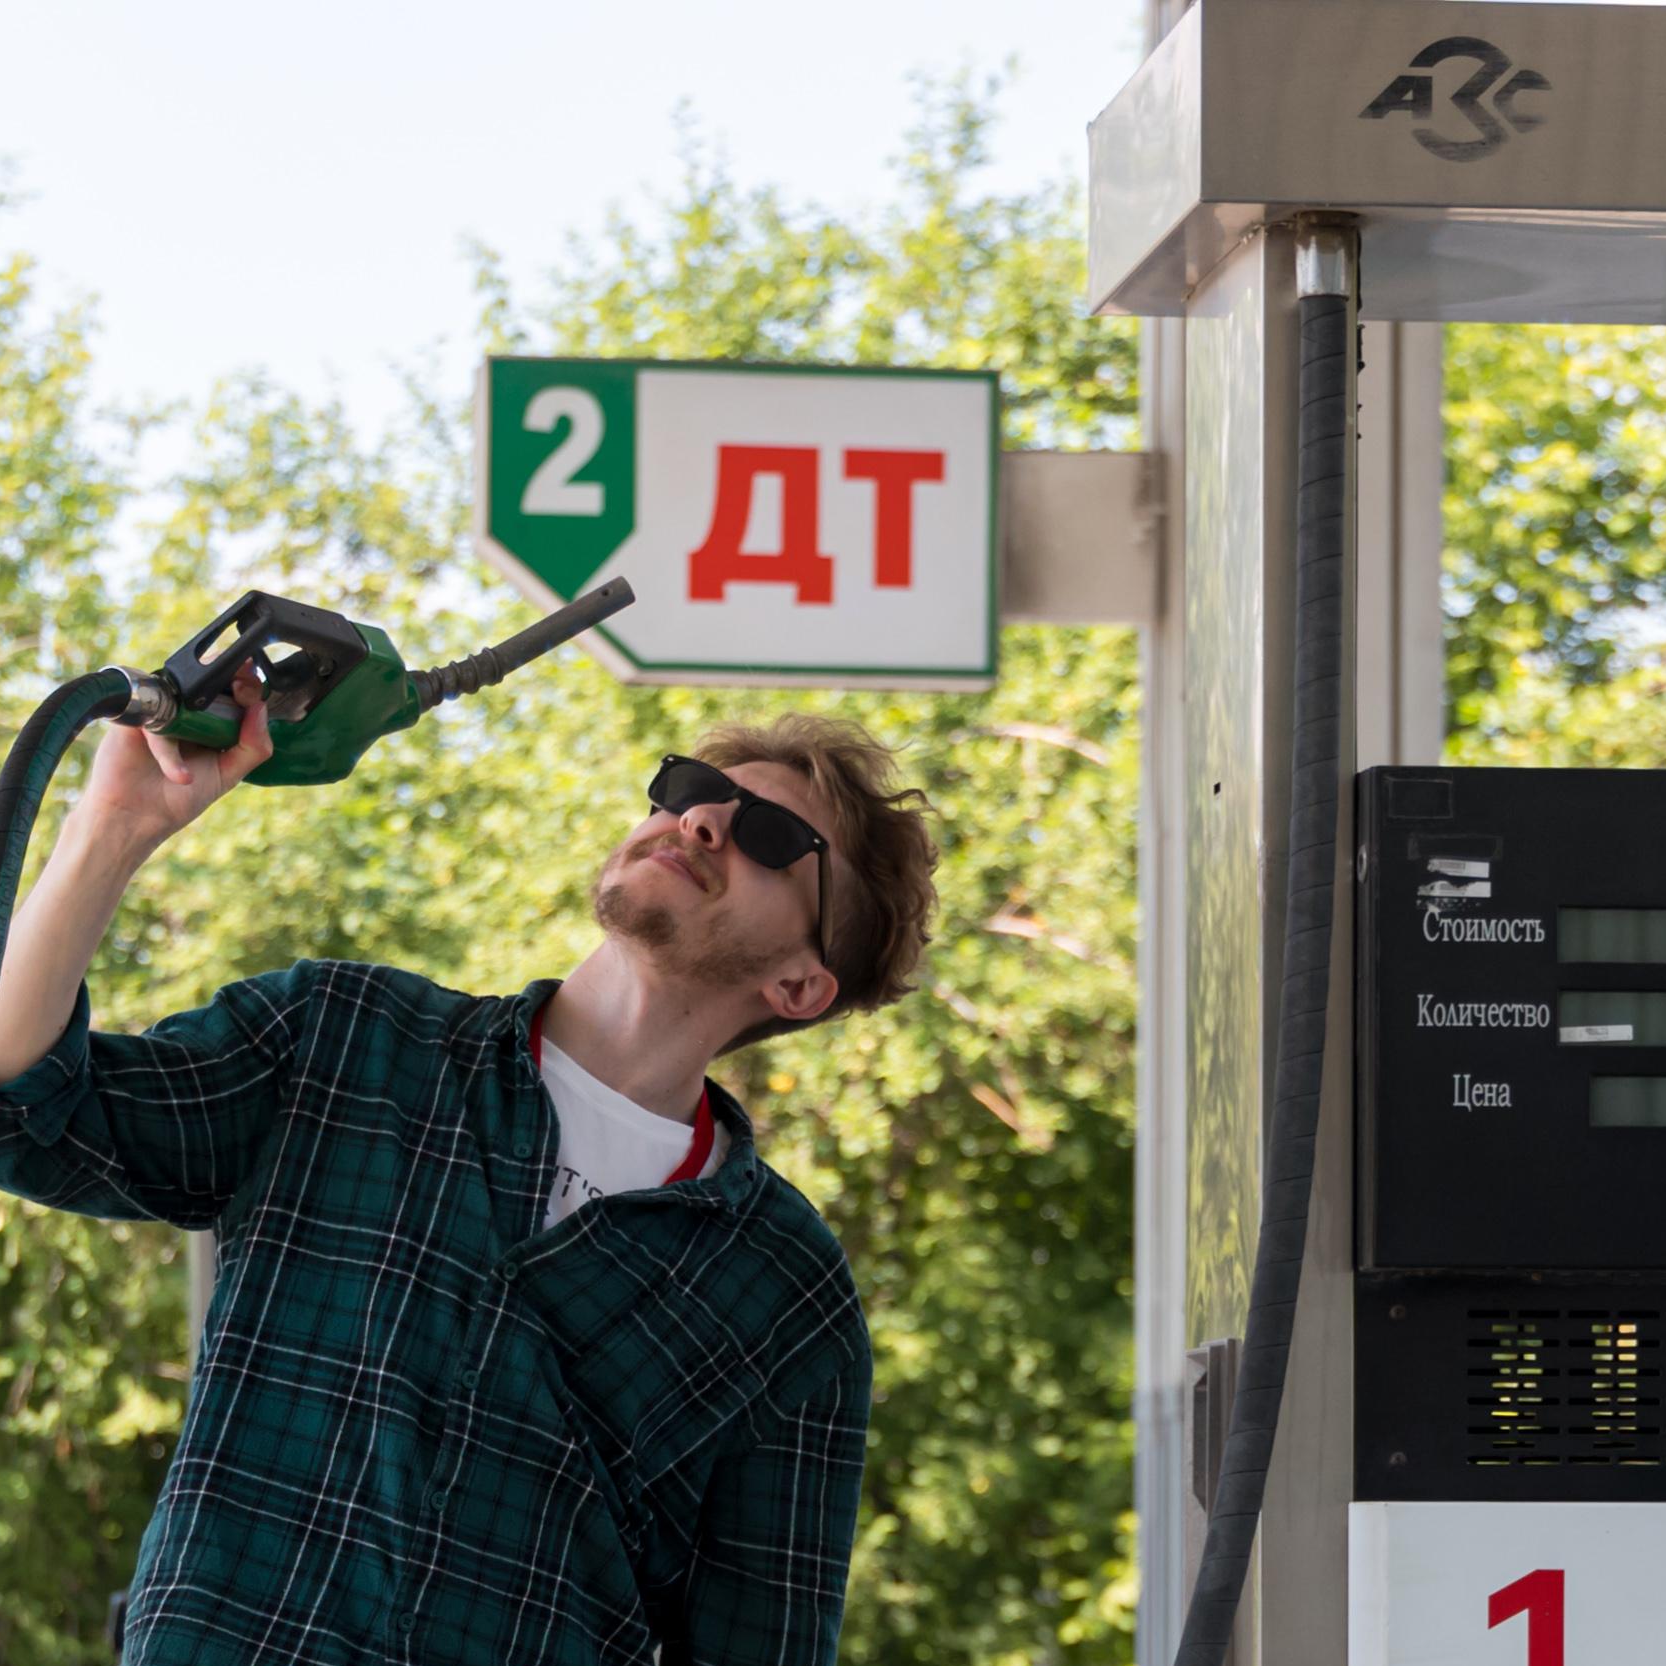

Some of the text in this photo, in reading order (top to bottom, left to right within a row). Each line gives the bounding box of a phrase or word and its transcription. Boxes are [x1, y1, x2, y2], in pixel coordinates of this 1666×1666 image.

[521, 387, 946, 606] 2 ДТ
[1422, 907, 1546, 943] Стоимость
[1416, 993, 1551, 1028] Количество
[1451, 1072, 1512, 1114] Цена
